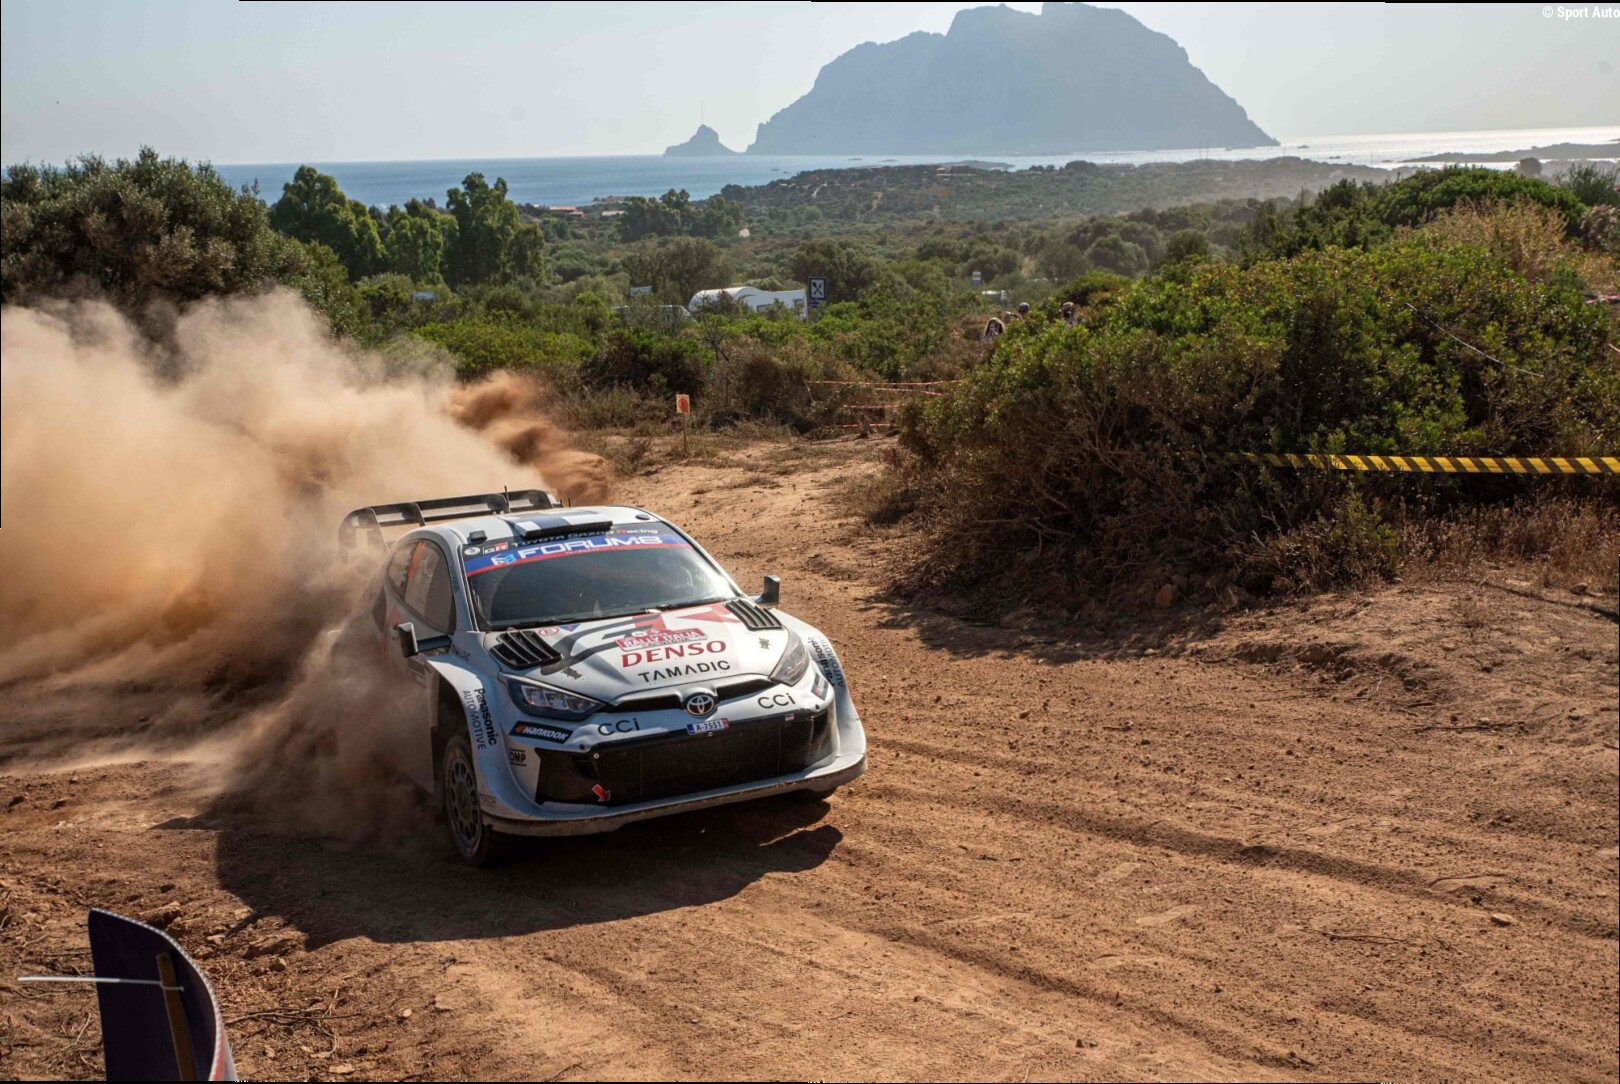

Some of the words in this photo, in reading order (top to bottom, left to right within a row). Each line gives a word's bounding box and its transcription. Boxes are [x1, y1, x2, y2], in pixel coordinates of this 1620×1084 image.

[517, 535, 662, 560] FORUM8
[621, 640, 727, 668] DENSO
[638, 660, 731, 684] TAMADIC
[462, 690, 487, 750] AUTOMOTIVE
[474, 688, 498, 746] Panasonic
[696, 721, 722, 731] A-7551
[509, 751, 527, 763] OMP
